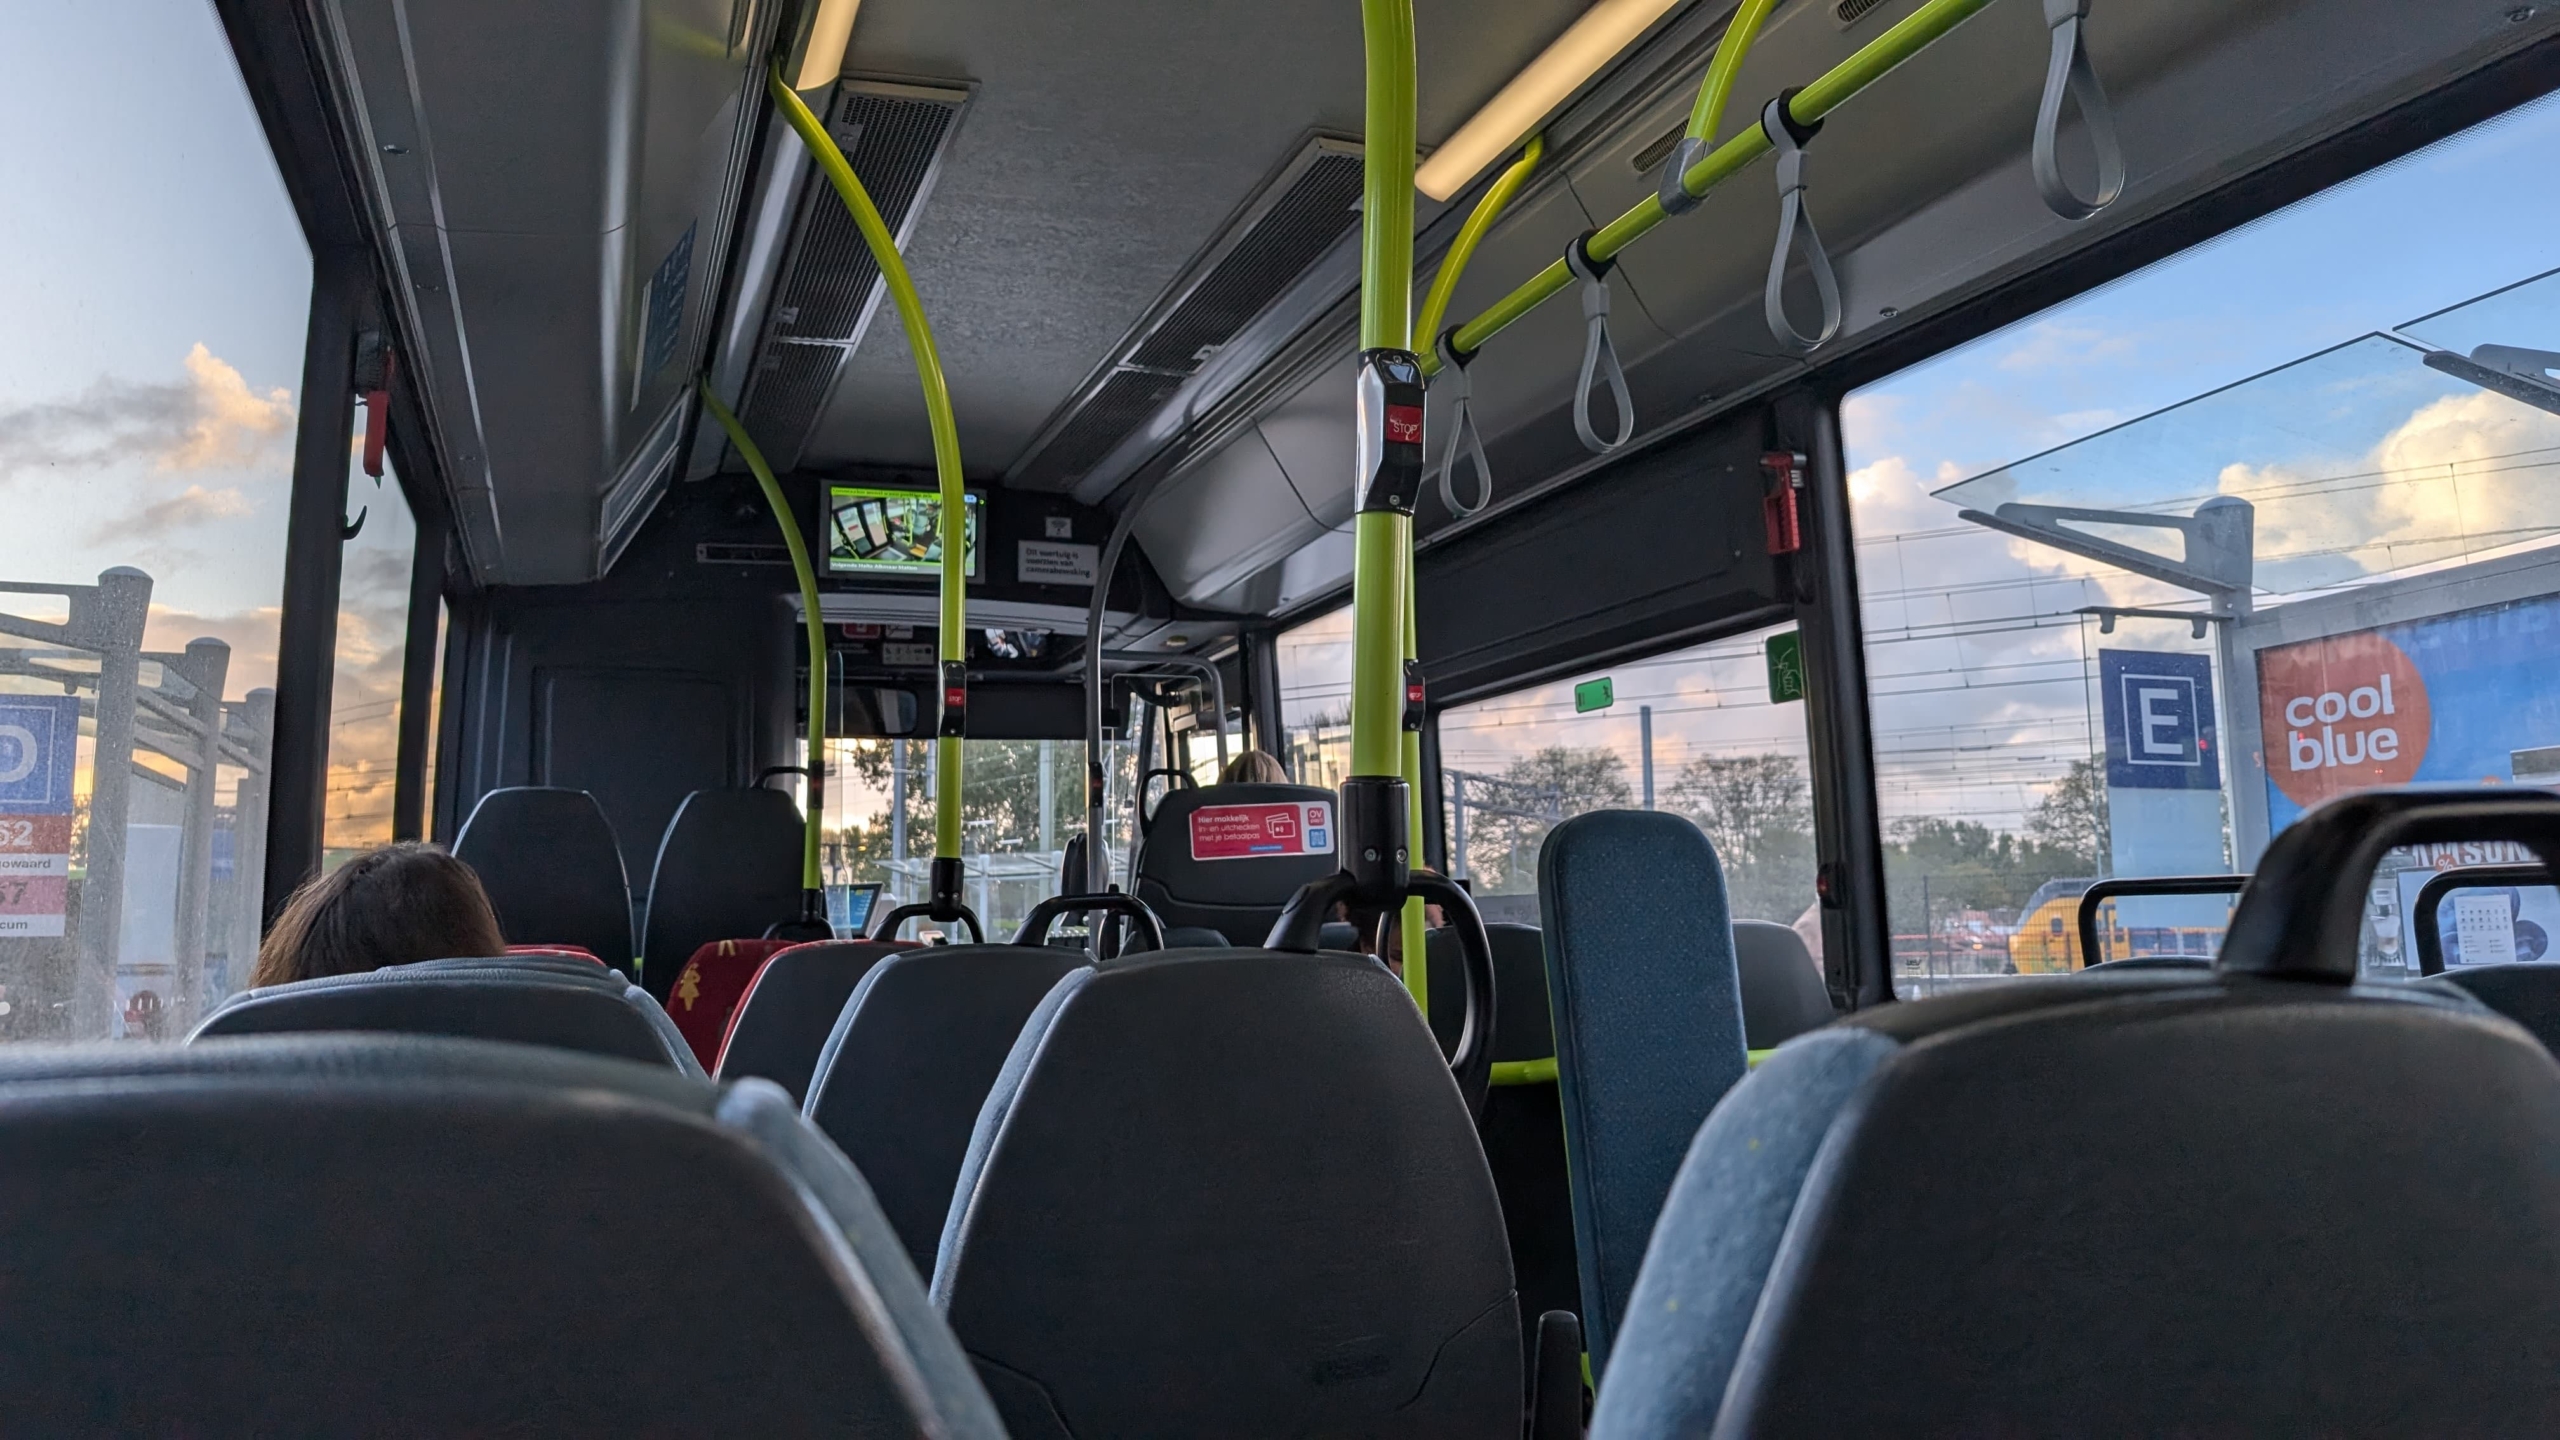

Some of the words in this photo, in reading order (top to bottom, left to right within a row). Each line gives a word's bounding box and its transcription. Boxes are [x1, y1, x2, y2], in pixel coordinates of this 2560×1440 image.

[1393, 421, 1418, 435] STOP
[948, 696, 961, 704] STOP
[2285, 673, 2395, 727] cool
[2139, 688, 2184, 755] E
[2288, 725, 2399, 771] blue
[1198, 816, 1213, 824] Hier
[1214, 814, 1249, 824] makkelijk
[1309, 809, 1323, 819] OV
[1209, 825, 1220, 833] en
[1220, 823, 1261, 832] uitchecken
[1199, 834, 1214, 842] met
[1214, 833, 1223, 843] je
[1223, 832, 1261, 841] betaalpas
[2391, 841, 2541, 867] AMSUN
[0, 858, 51, 870] owaard
